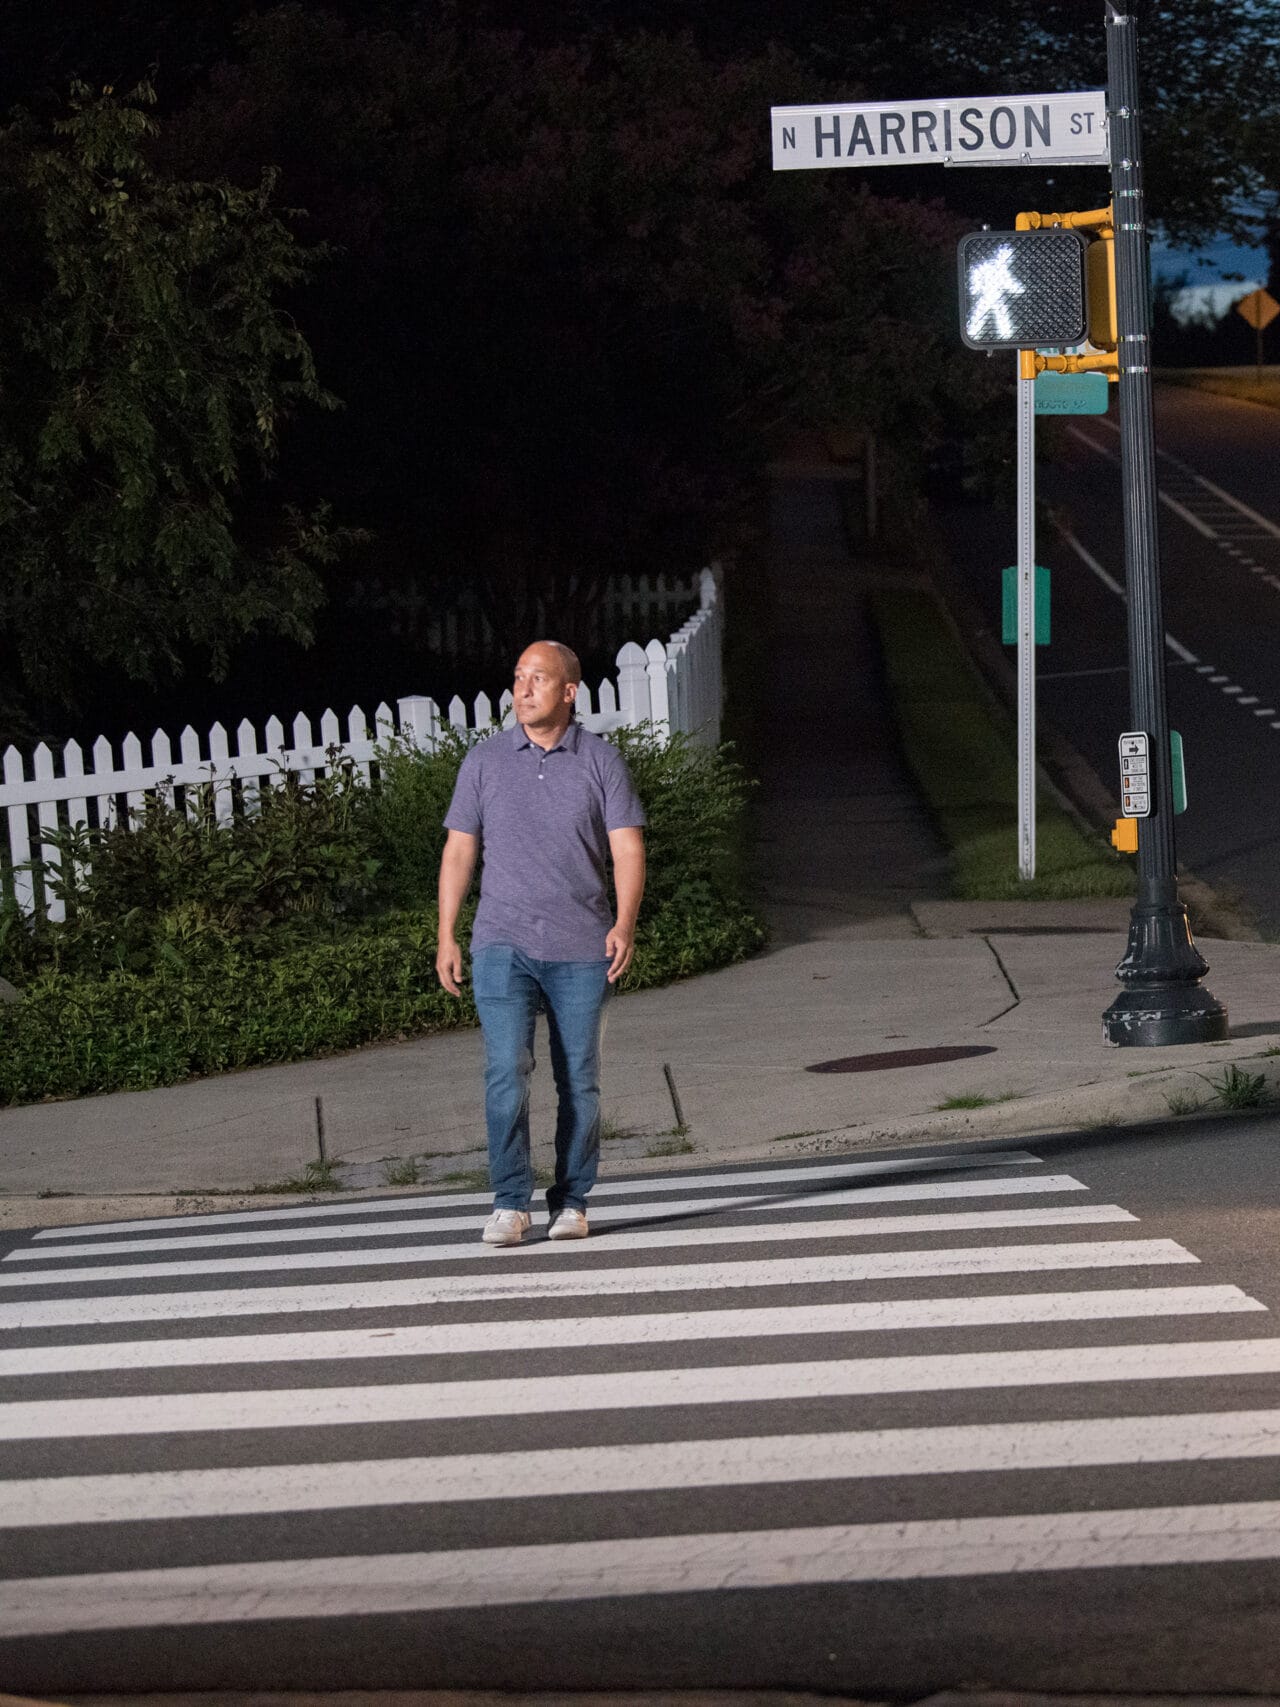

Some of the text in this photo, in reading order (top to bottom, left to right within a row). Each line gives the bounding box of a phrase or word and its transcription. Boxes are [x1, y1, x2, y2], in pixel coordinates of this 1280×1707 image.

[782, 104, 1095, 158] N HARRISON ST
